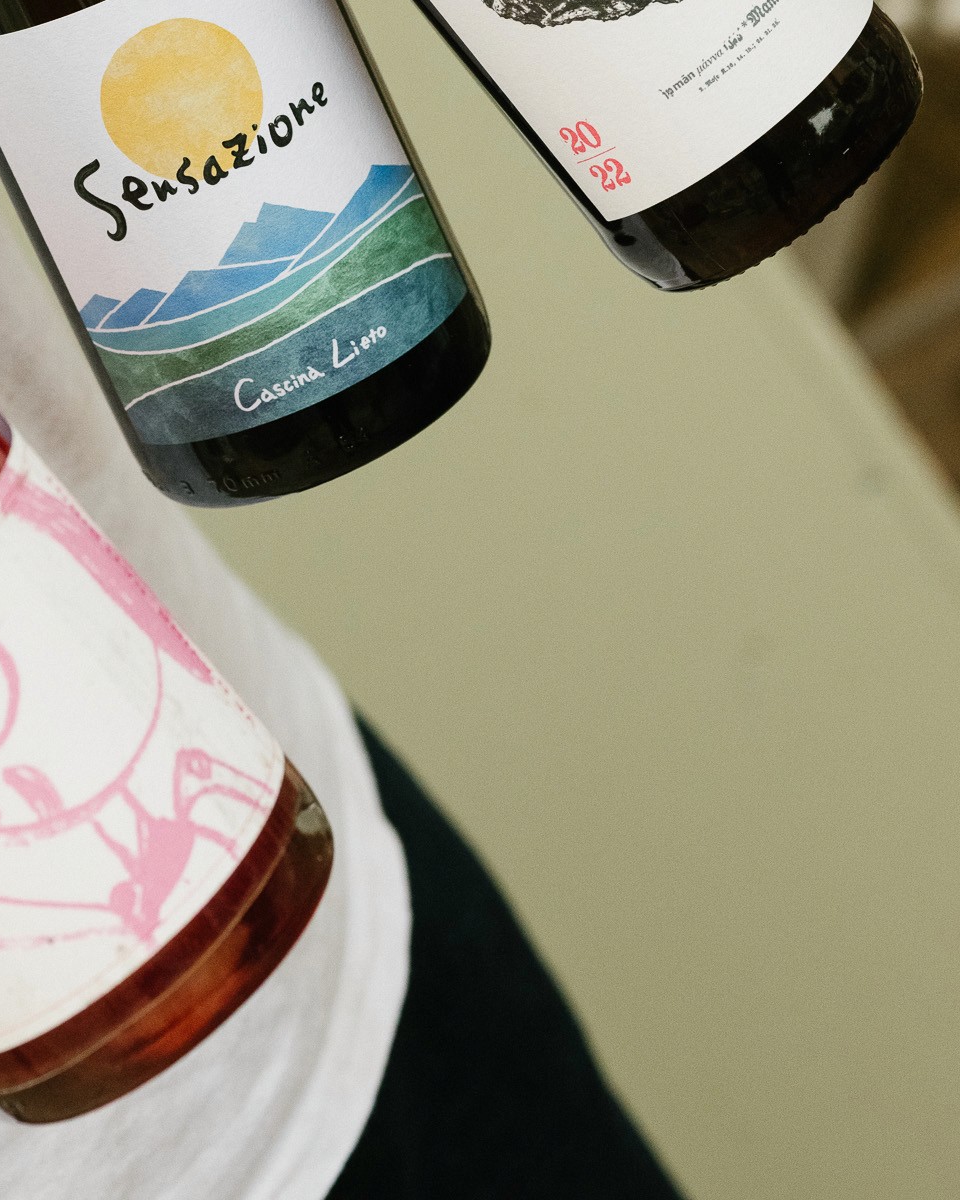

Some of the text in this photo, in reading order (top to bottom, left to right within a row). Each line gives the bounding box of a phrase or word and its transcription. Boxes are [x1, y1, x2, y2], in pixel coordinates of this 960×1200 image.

[74, 81, 328, 242] Sensazione
[559, 120, 602, 155] 20
[589, 158, 632, 193] 22
[234, 322, 388, 412] Cascina Lieto
